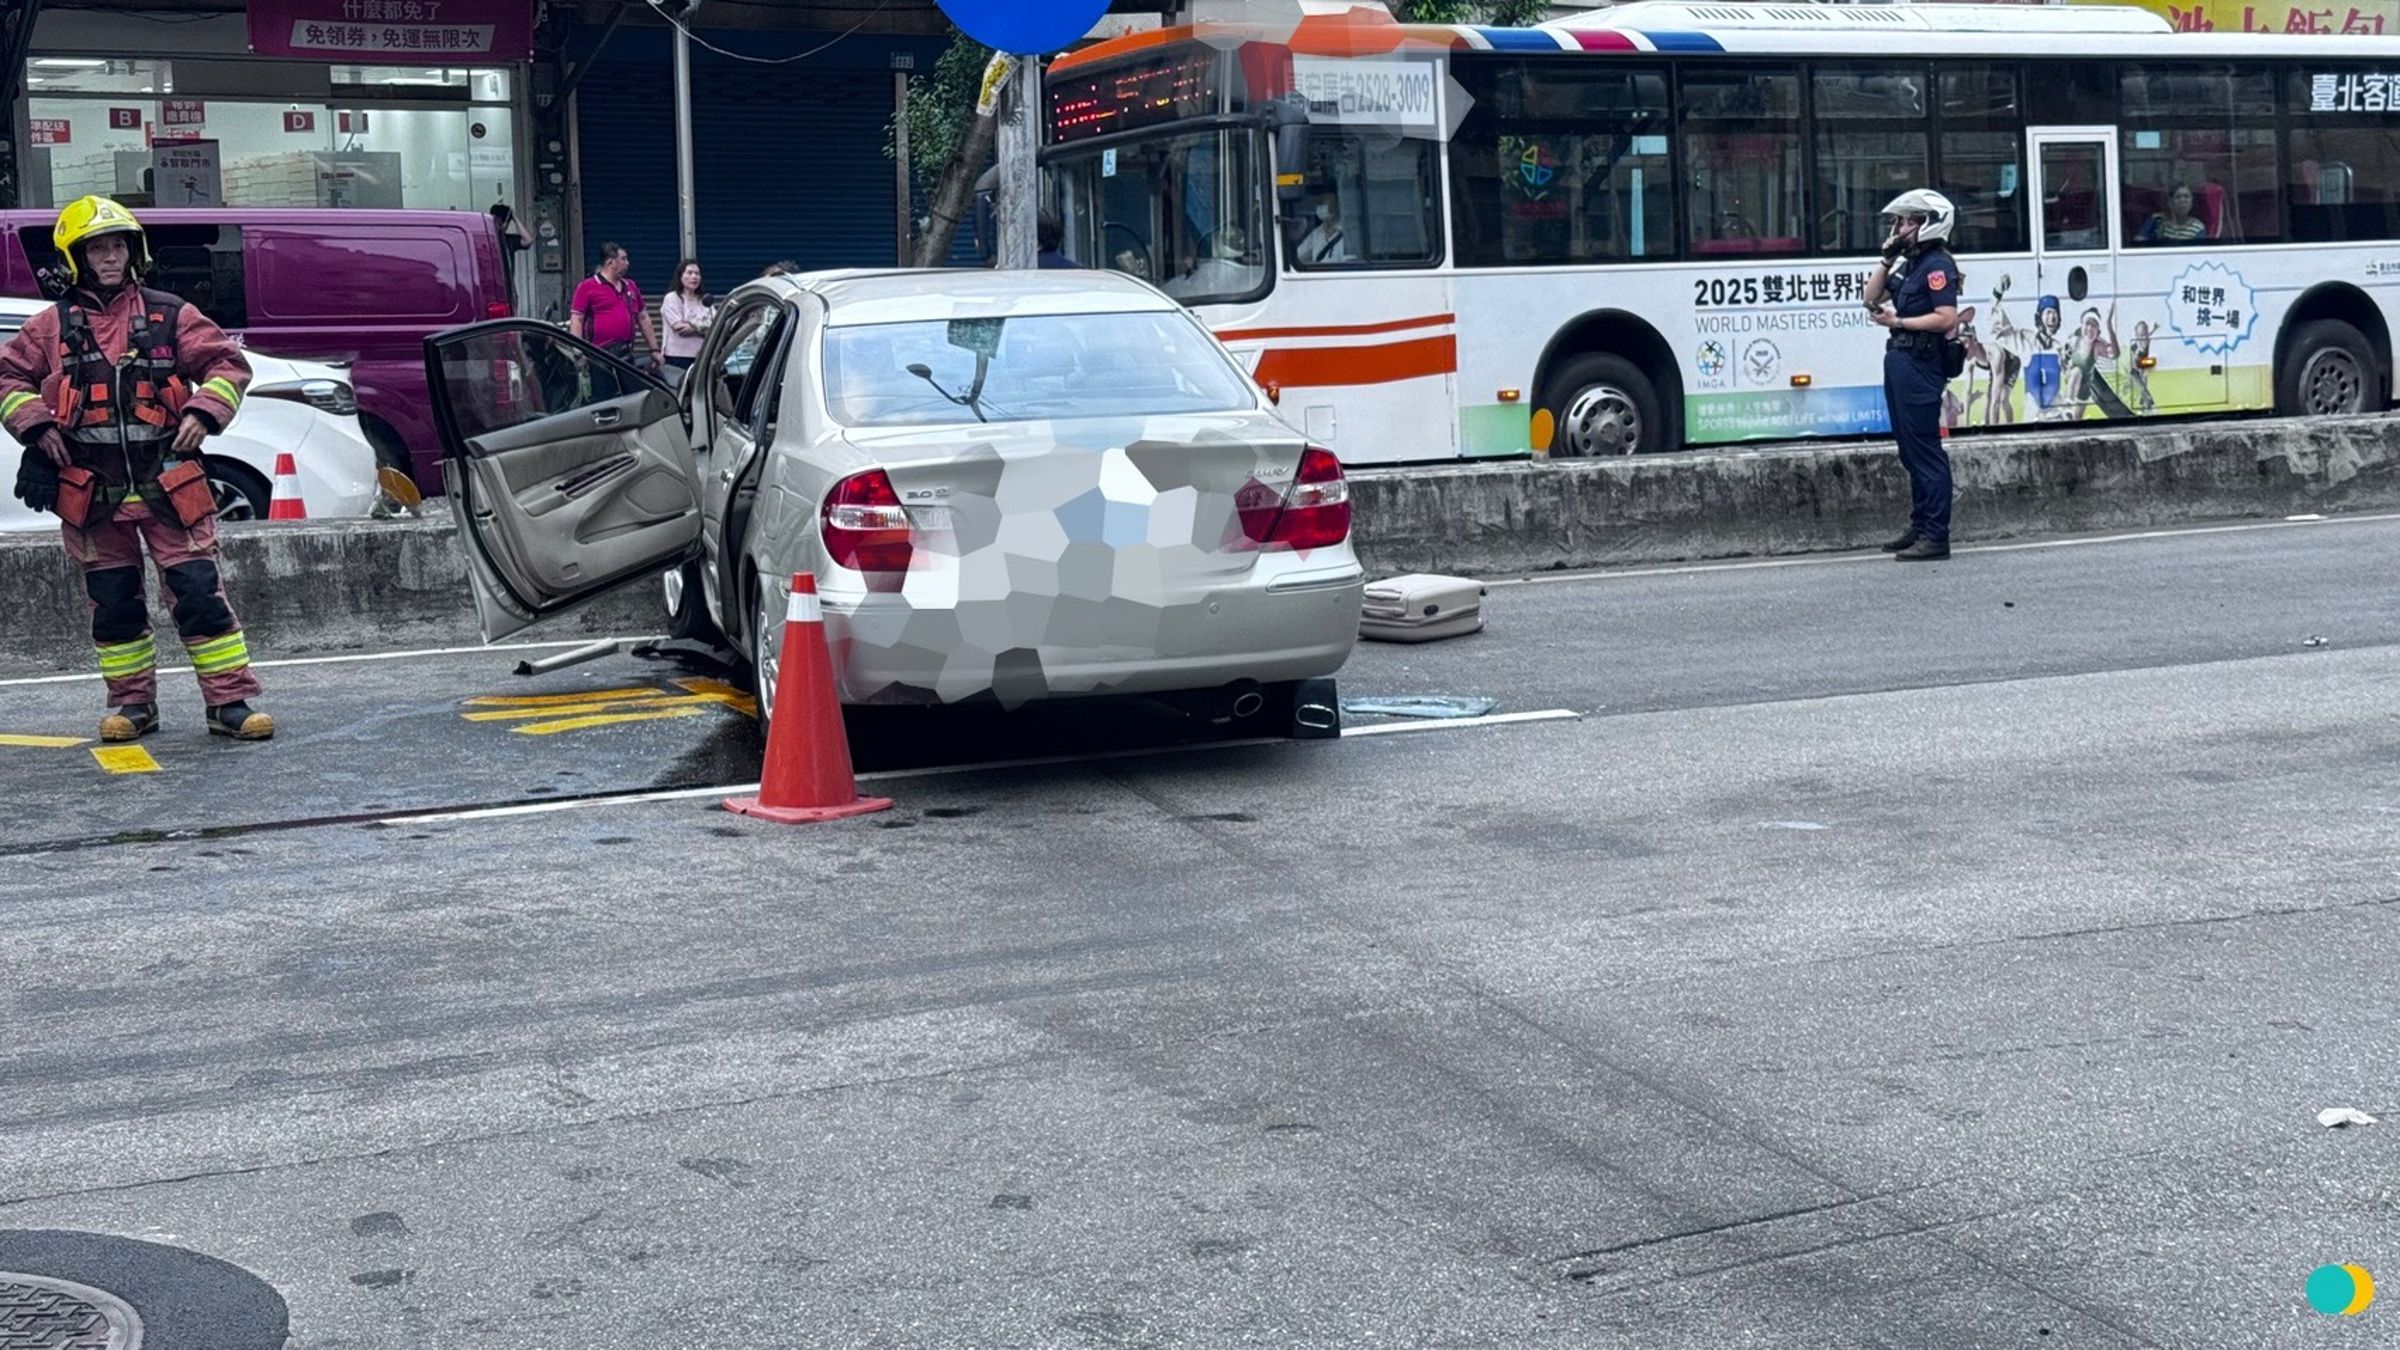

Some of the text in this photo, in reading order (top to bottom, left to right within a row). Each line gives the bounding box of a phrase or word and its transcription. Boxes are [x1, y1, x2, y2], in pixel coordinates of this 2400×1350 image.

[342, 0, 441, 21] 什麼都免了
[305, 24, 480, 49] 免領券，免運無限次
[119, 111, 132, 126] B
[292, 114, 306, 129] D
[1695, 278, 1758, 306] 2025
[2182, 285, 2225, 307] 和世界
[1695, 315, 1751, 334] WORLD
[1757, 311, 1827, 331] MASTERS
